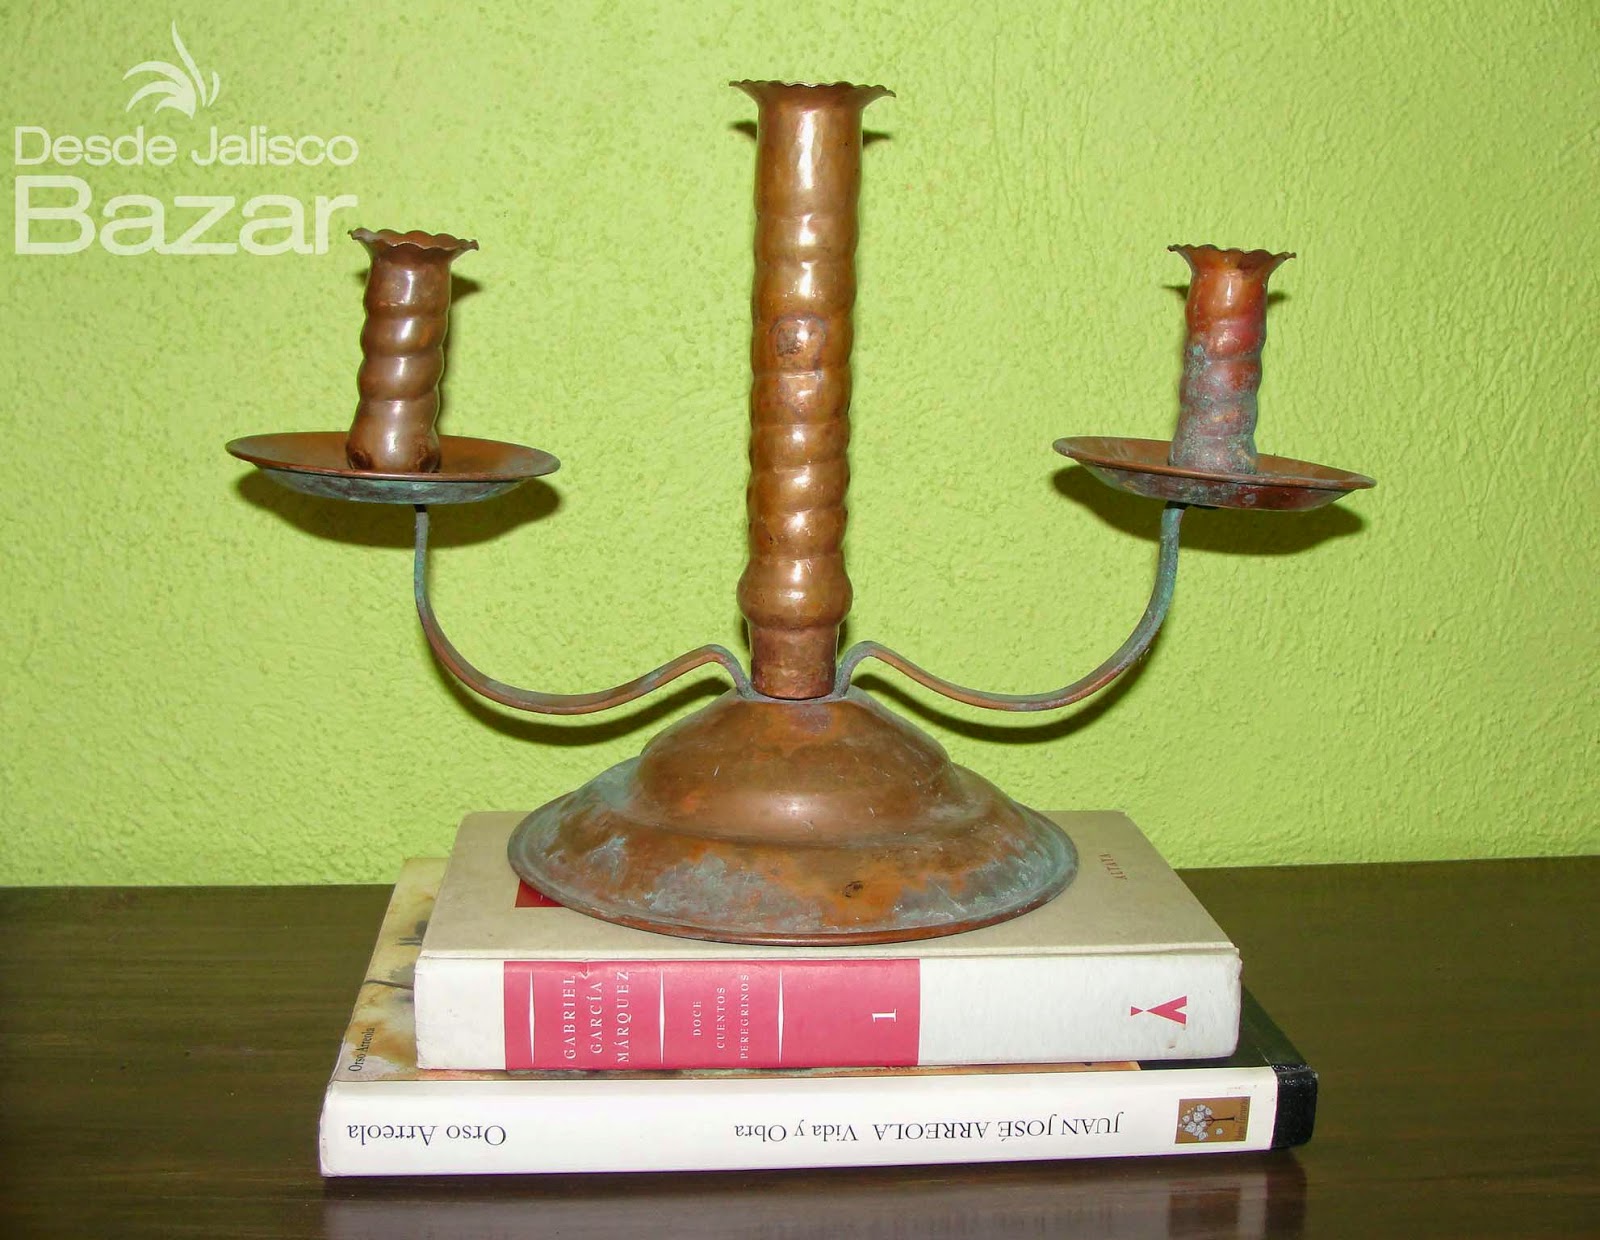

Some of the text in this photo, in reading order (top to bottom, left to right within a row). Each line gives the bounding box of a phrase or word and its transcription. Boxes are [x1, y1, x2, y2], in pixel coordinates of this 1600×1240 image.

[563, 976, 577, 1059] GABRIEL
[586, 982, 603, 1055] GARCÍA
[613, 970, 632, 1063] MÁRQUEZ
[693, 1001, 702, 1037] DOCE
[716, 987, 726, 1050] CUENTOS
[740, 974, 750, 1060] PEREGRINOS
[348, 1027, 375, 1071] Orso Arreola
[347, 1125, 507, 1146] Orso Arreola
[735, 1111, 1125, 1143] JUAN JOSÉ ARREOLA Vida y Obra
